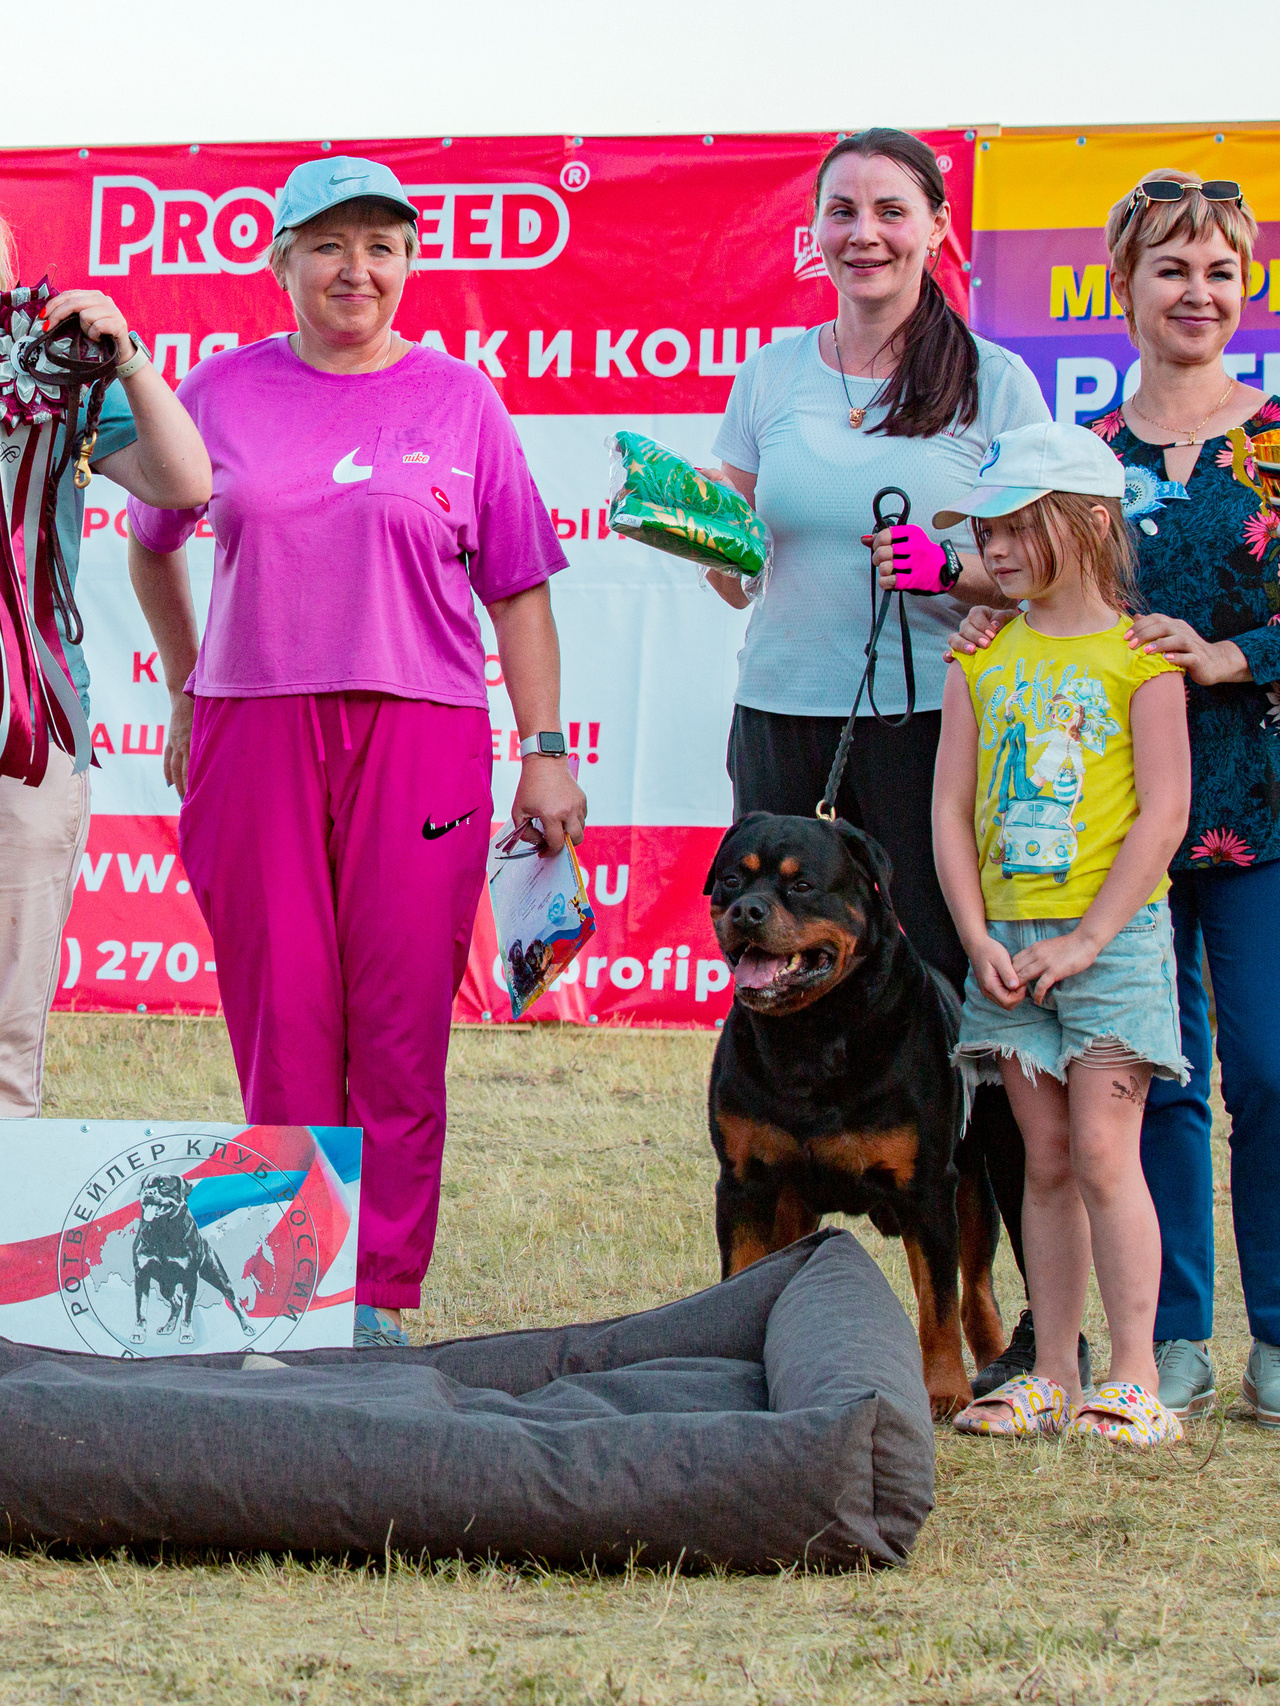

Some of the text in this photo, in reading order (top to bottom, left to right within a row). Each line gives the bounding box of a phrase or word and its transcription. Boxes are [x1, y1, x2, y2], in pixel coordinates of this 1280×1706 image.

[88, 174, 571, 277] PROEED
[528, 330, 572, 378] И
[595, 326, 806, 379] КОШ
[402, 452, 430, 464] nike
[430, 817, 470, 830] NIKE
[62, 1138, 315, 1323] РОТВЕЙЛЕР КЛУБ РОССИИ
